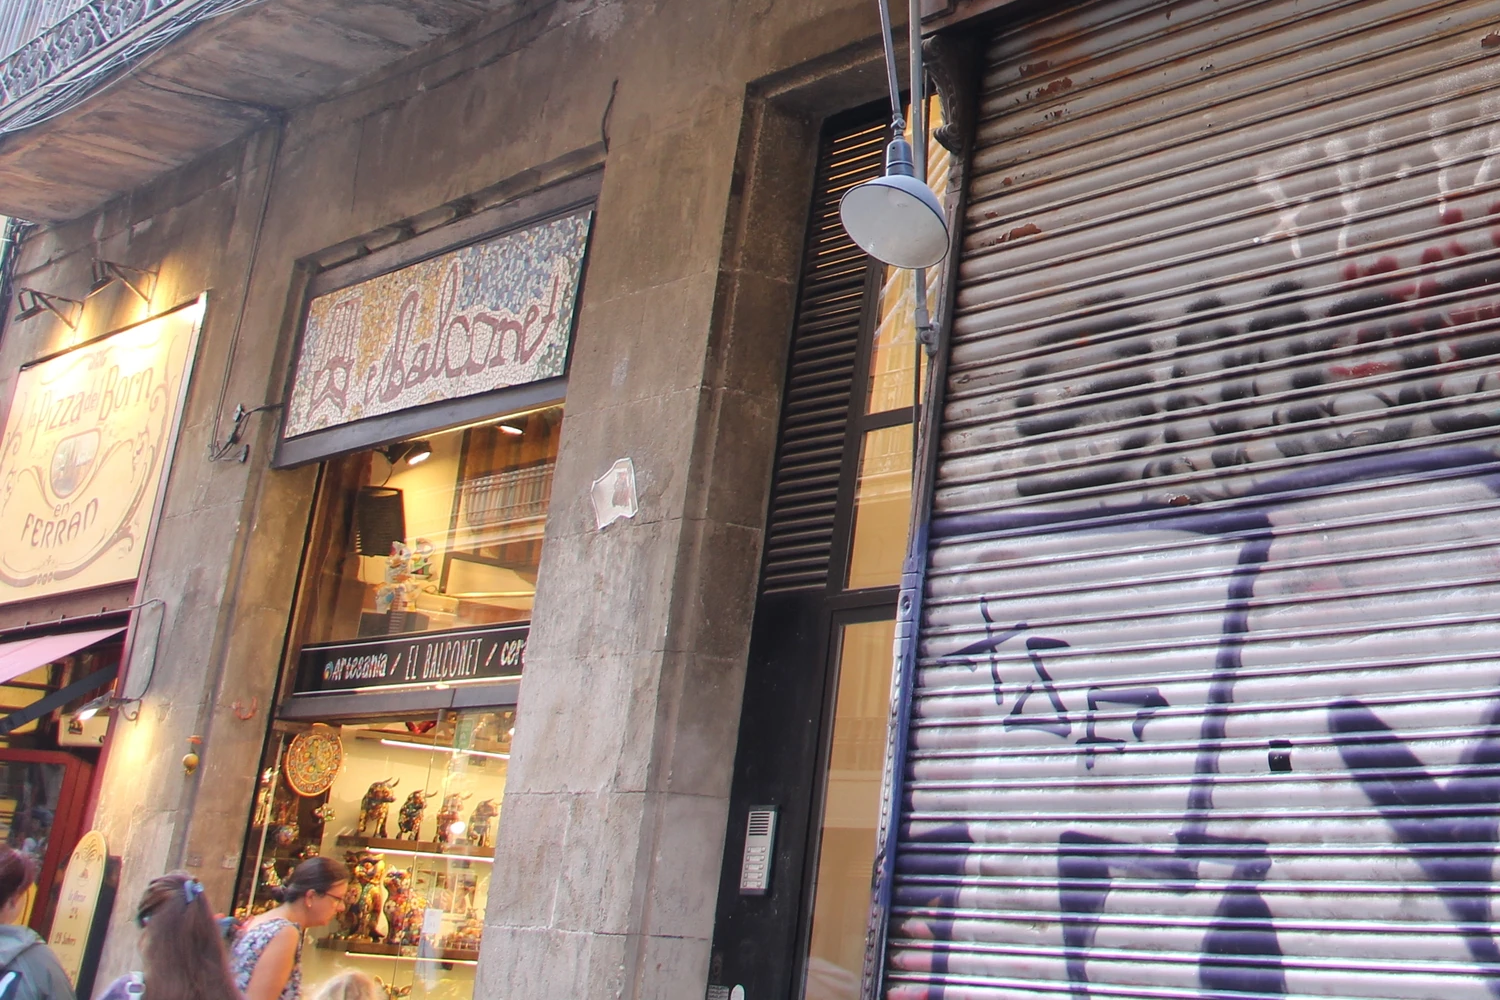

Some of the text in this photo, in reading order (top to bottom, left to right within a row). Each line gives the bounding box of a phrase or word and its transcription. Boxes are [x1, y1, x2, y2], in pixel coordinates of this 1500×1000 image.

[380, 262, 560, 404] Balconet
[97, 364, 154, 422] Born
[21, 497, 99, 549] FERRAN
[54, 502, 70, 517] en
[405, 644, 418, 681] EL
[423, 638, 483, 679] BALCONET
